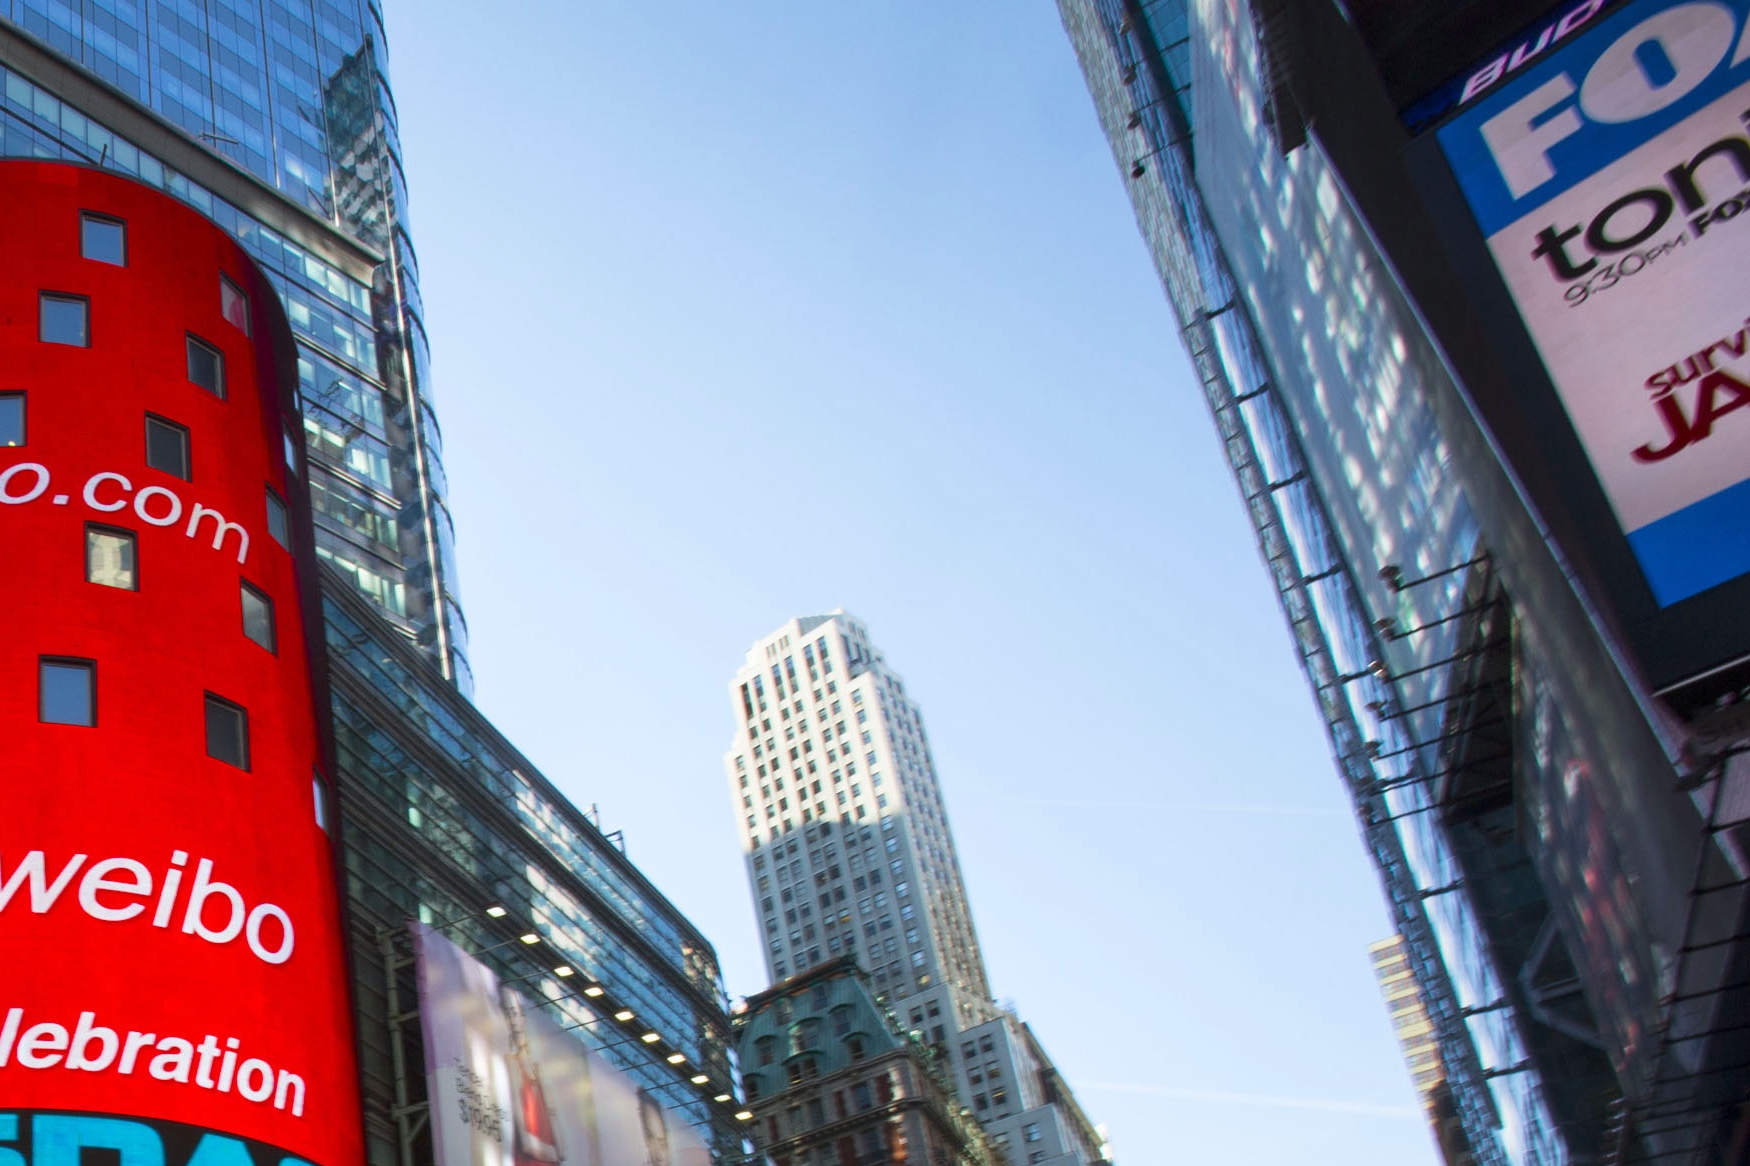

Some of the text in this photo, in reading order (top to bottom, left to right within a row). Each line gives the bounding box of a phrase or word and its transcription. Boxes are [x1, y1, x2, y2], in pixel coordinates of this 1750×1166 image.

[1479, 0, 1750, 201] FO
[1530, 109, 1750, 283] ton
[1644, 316, 1750, 400] surv
